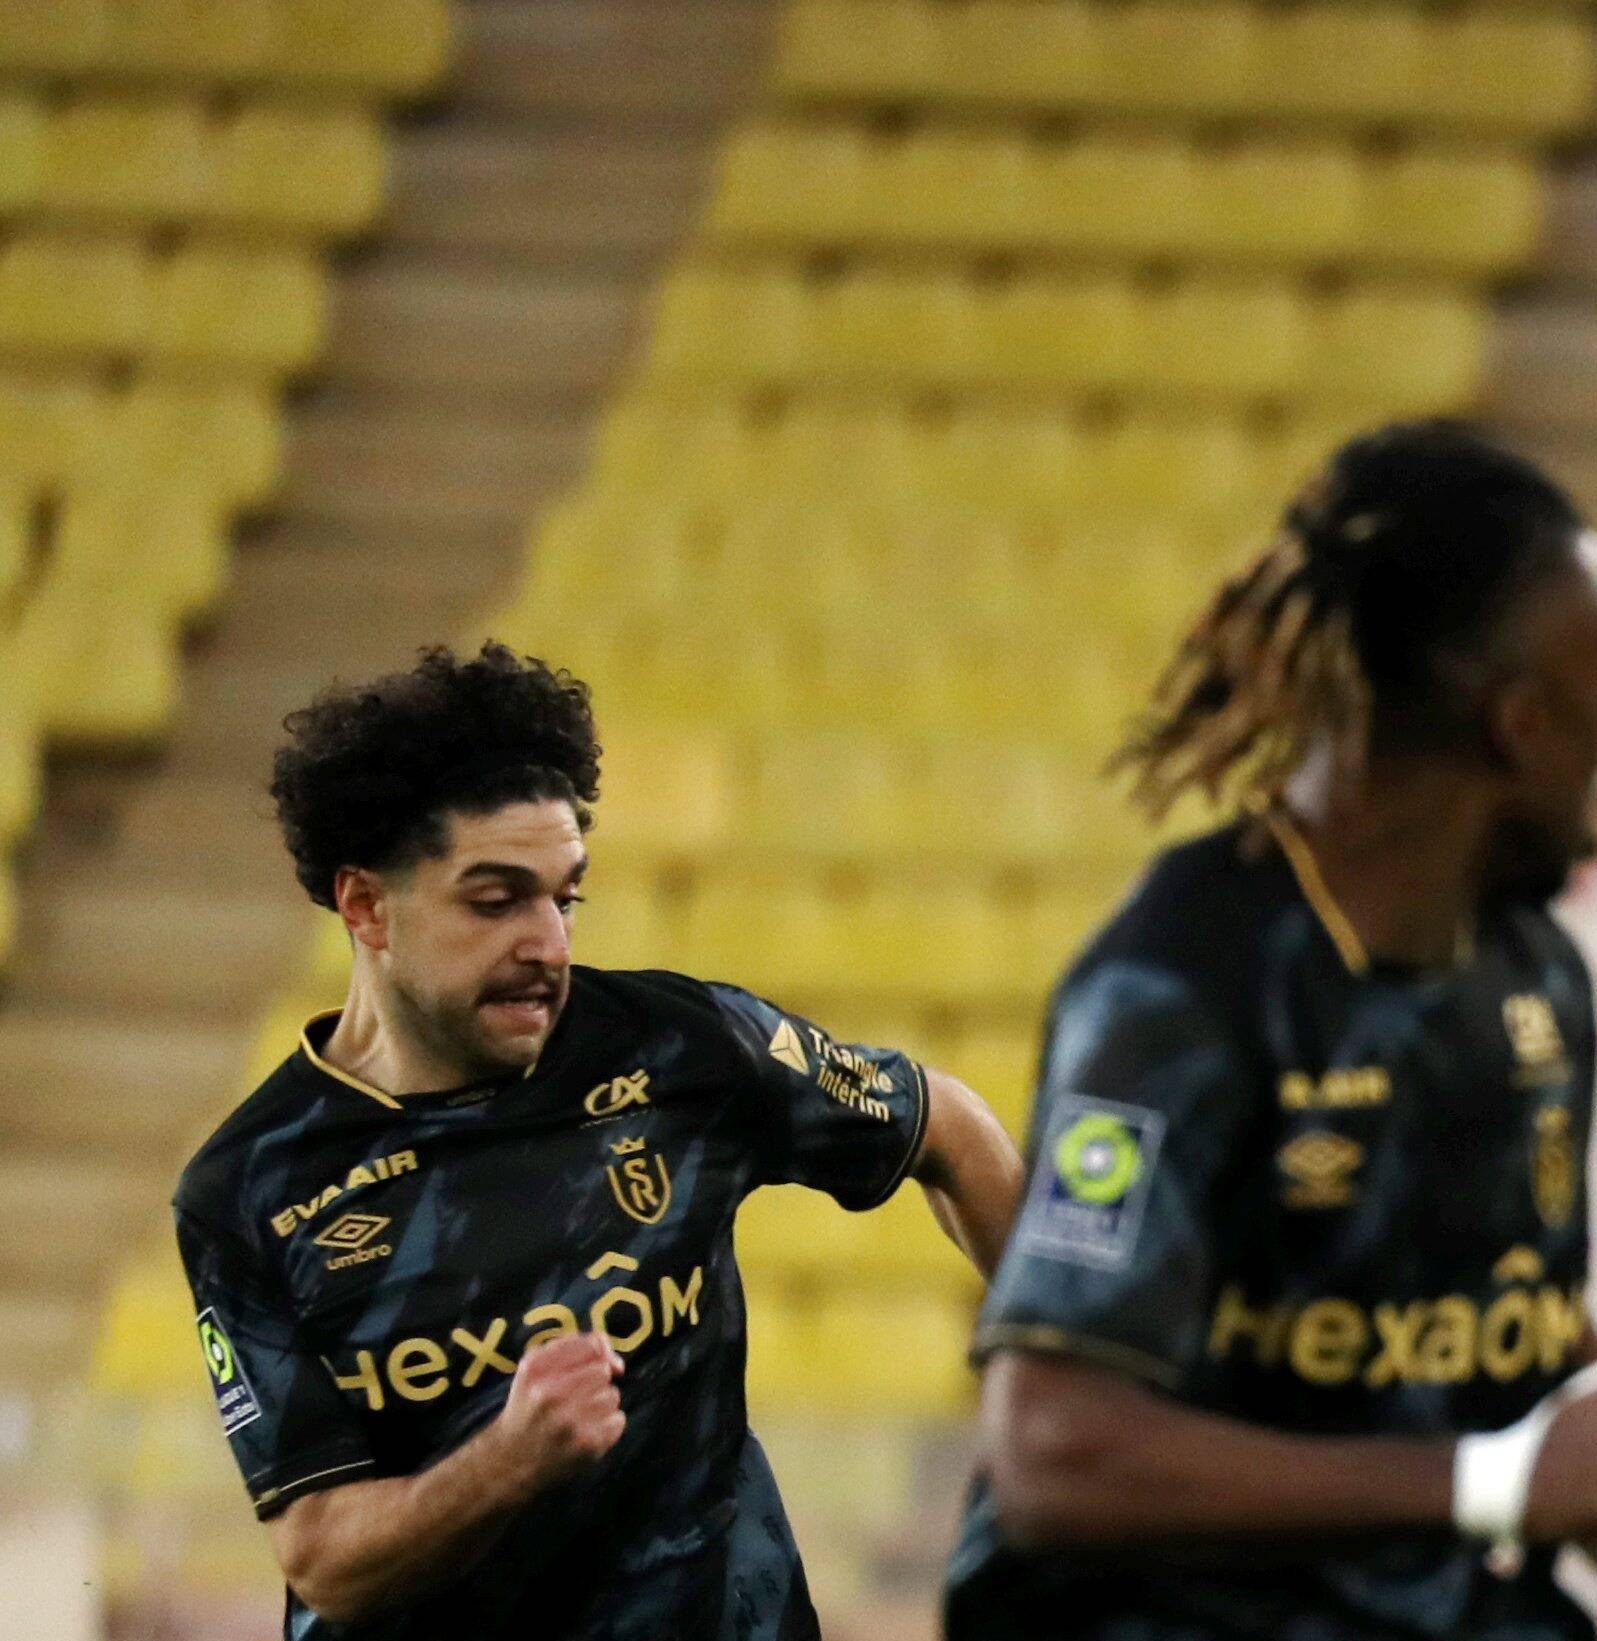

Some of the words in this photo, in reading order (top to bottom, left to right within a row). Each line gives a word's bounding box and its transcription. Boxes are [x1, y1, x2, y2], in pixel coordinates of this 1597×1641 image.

[808, 1026, 894, 1094] Triangle
[817, 1060, 890, 1123] intérim
[325, 1243, 393, 1271] umbro
